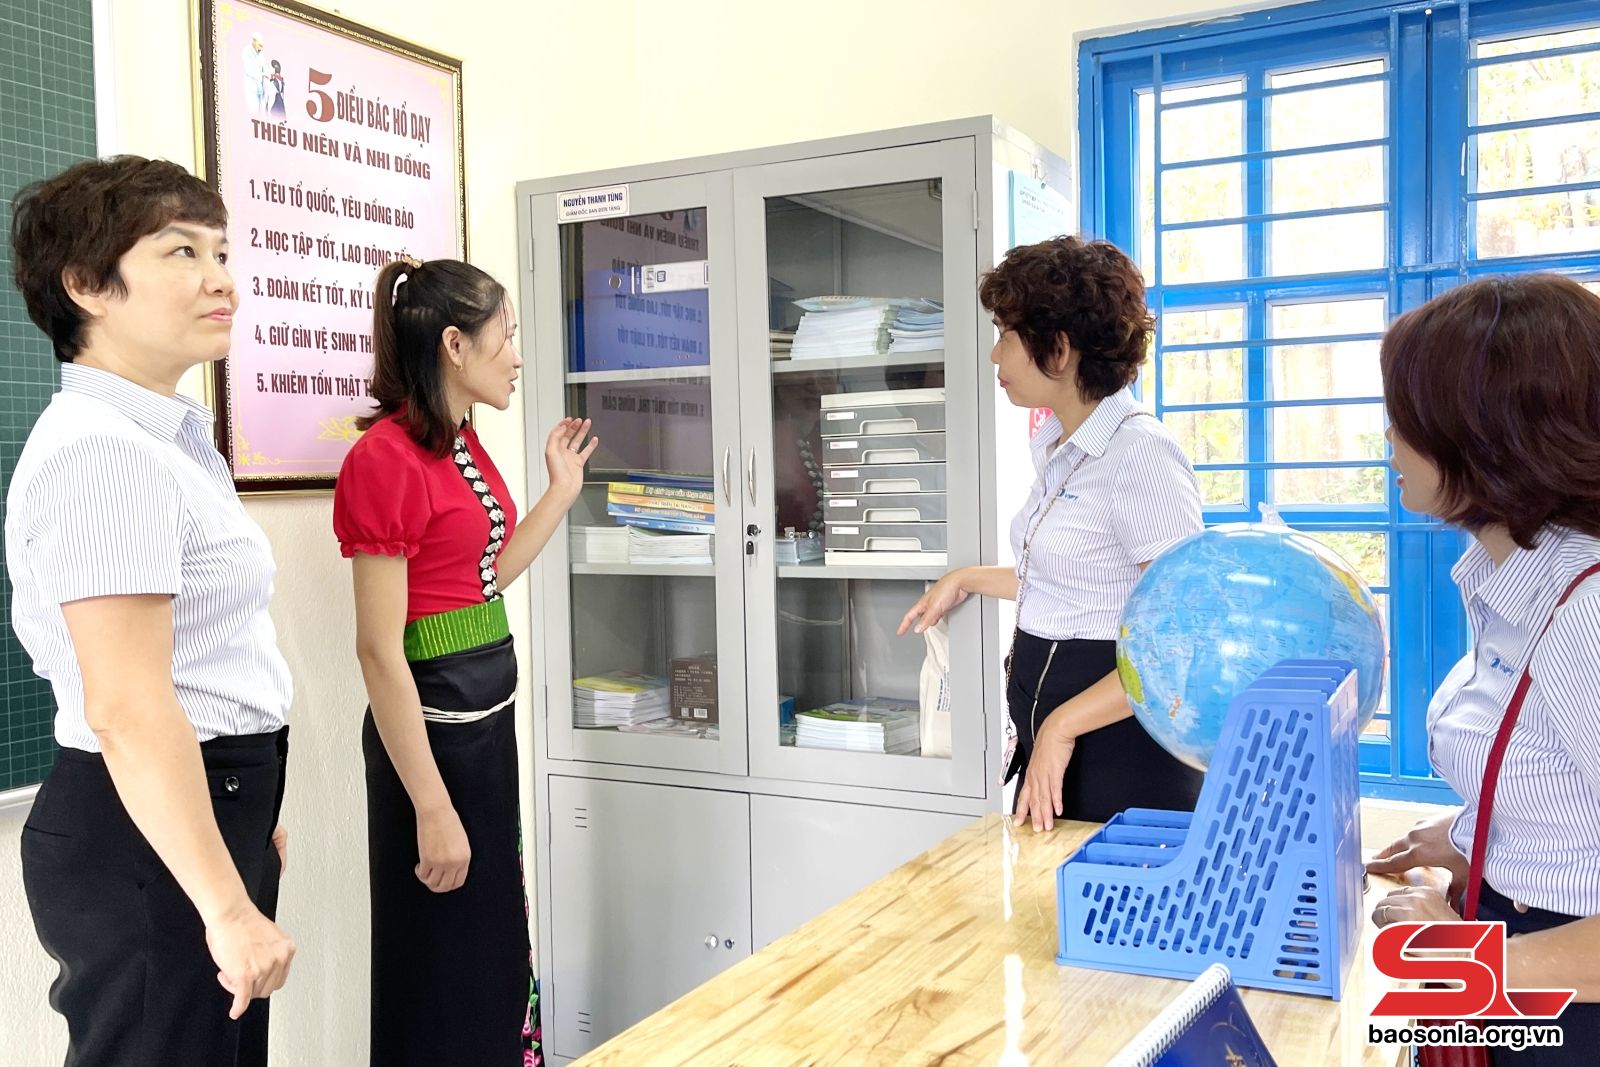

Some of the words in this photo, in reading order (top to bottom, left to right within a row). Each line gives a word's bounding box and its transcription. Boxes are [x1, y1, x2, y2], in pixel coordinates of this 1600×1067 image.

[306, 67, 335, 122] 5
[337, 85, 363, 125] ĐIỀU
[367, 97, 389, 132] BÁC
[393, 101, 408, 137] HỒ
[411, 112, 431, 148] DẠY
[251, 118, 298, 148] THIẾU
[303, 132, 339, 158] NIÊN
[343, 141, 362, 164] VÀ
[366, 148, 390, 170] NHI
[394, 153, 431, 180] ĐỒNG
[249, 179, 260, 200] 1.
[263, 179, 286, 204] YÊU
[289, 181, 303, 208] TỔ
[306, 187, 339, 218] QUỐC,
[341, 195, 361, 219] YÊU
[364, 198, 392, 225] ĐỒNG
[394, 206, 414, 229] BÀO
[587, 194, 606, 204] THANH
[251, 227, 262, 248] 2.
[265, 230, 289, 255] HỌC
[292, 231, 313, 259] TẬP
[316, 233, 339, 263] TỐT,
[342, 243, 361, 264] LAO
[364, 244, 392, 270] ĐỘNG
[253, 276, 264, 296] 3.
[267, 275, 299, 300] ĐOÀN
[302, 277, 322, 303] KẾT
[325, 280, 347, 309] TỐT,
[350, 282, 363, 308] KỶ
[255, 324, 266, 344] 4.
[269, 321, 290, 346] GIỮ
[292, 324, 312, 348] GÌN
[314, 326, 328, 354] VỆ
[331, 331, 357, 352] SINH
[256, 372, 268, 392] 5.
[271, 370, 308, 394] KHIÊM
[310, 369, 332, 395] TỐN
[335, 374, 360, 400] THẬT
